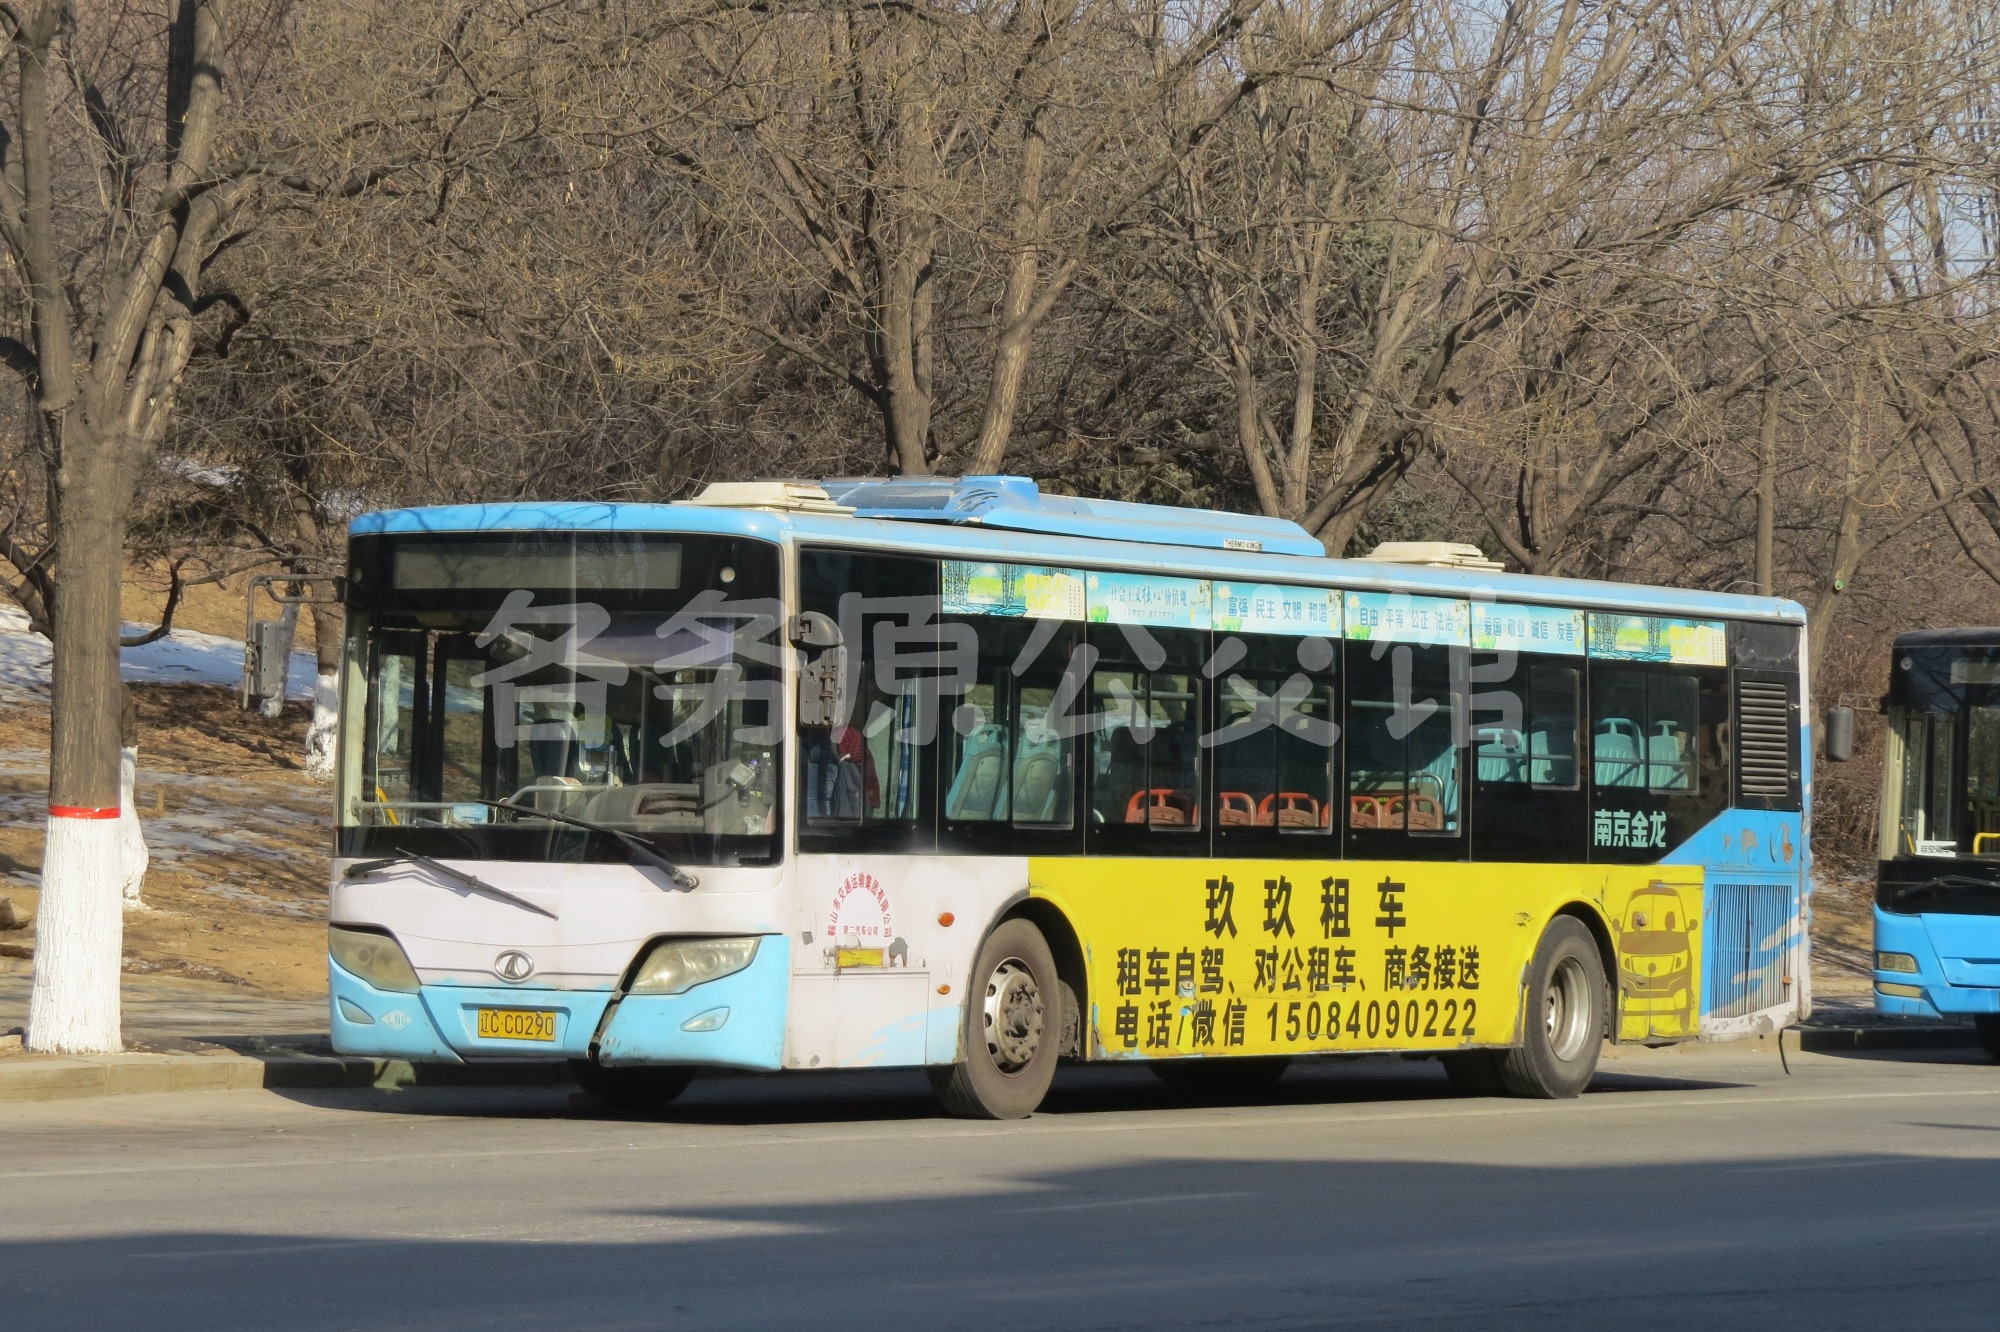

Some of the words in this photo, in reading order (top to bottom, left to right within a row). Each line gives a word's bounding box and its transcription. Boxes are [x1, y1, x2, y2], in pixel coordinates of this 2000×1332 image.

[1225, 540, 1245, 549] THERMO
[1246, 541, 1258, 550] KING
[1111, 583, 1187, 607] 社会主义核心价值观
[1228, 596, 1248, 618] 富强
[1256, 599, 1275, 619] 民主
[1283, 600, 1301, 621] 文明
[1309, 602, 1328, 622] 和谐
[1360, 606, 1378, 626] 自由
[1386, 608, 1404, 628] 平等
[1411, 610, 1429, 630] 公正
[1435, 611, 1453, 631] 法治
[1484, 617, 1501, 636] 爱国
[1508, 618, 1525, 637] 敬业
[1531, 620, 1548, 639] 诚信
[1557, 622, 1574, 641] 友善
[1594, 808, 1667, 848] 南京金龙
[1204, 874, 1407, 939] 玖玖租车
[388, 1012, 408, 1026] LNG
[1267, 998, 1477, 1042] 15084090222
